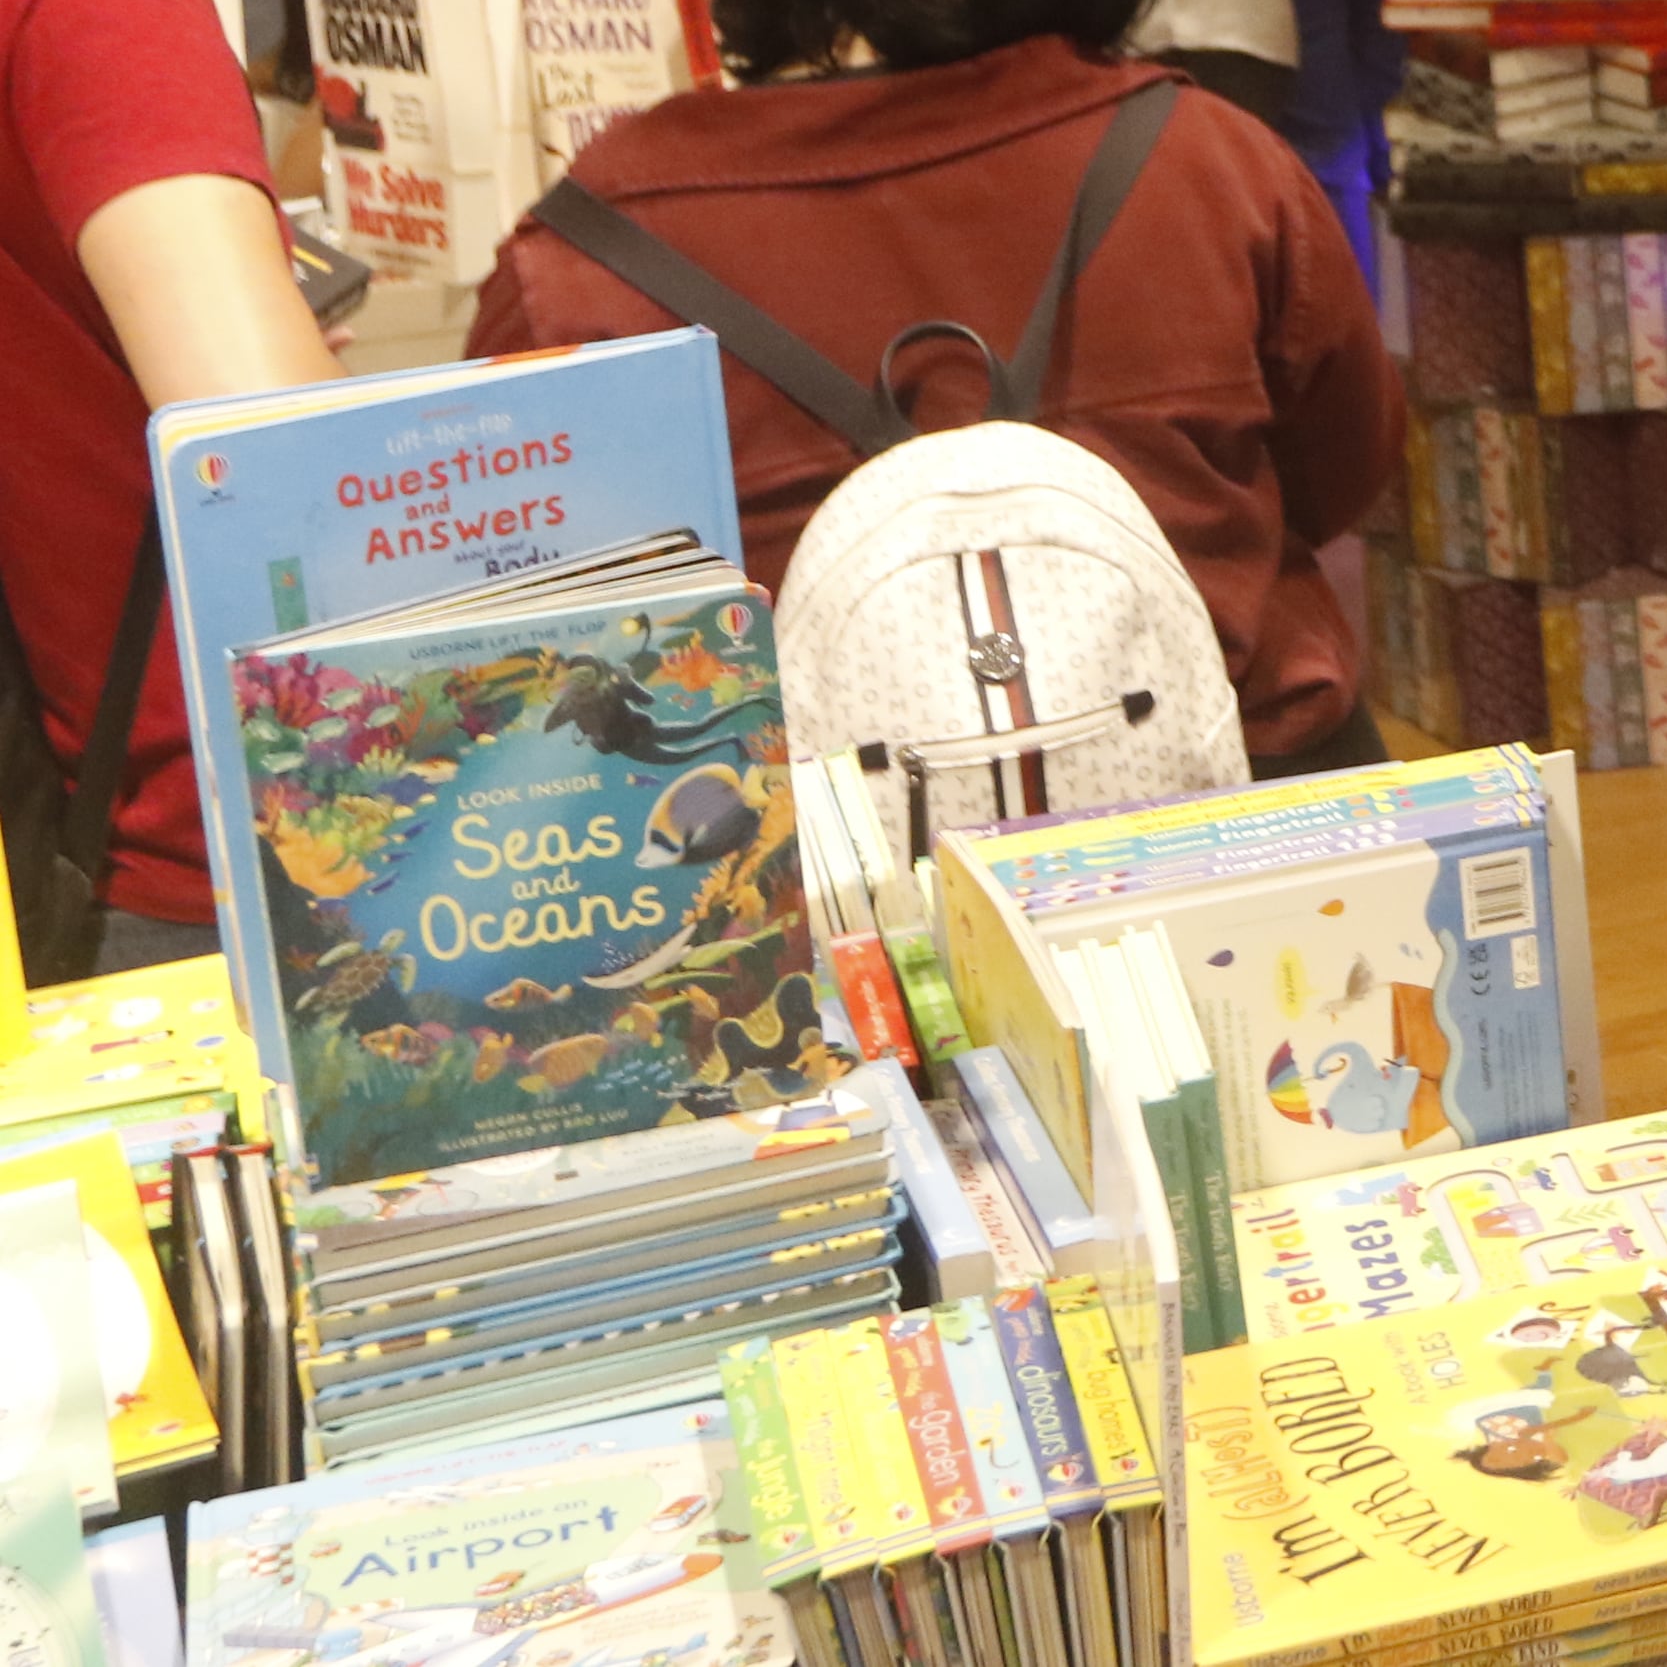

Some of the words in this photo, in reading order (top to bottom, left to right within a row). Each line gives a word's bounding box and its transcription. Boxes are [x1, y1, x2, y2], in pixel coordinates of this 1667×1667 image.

[525, 18, 653, 54] OSMAN
[337, 433, 574, 509] Questions
[364, 494, 568, 565] Answers
[405, 493, 452, 521] and
[409, 637, 486, 662] USBORNE
[525, 625, 560, 645] THE
[566, 618, 607, 638] FLAP
[457, 787, 521, 812] LOOK
[527, 772, 603, 801] INSIDE
[1215, 800, 1340, 831] Fingertrail
[451, 814, 624, 879] Seas
[1215, 831, 1332, 861] Fingertrail
[1218, 811, 1345, 844] Fingertrail
[1213, 845, 1331, 875] Fingertrail
[511, 867, 581, 902] and
[419, 885, 666, 961] Oceans
[1345, 1218, 1421, 1321] Mazes
[1418, 1331, 1466, 1391] HOLES
[1016, 1364, 1069, 1456] dinosaurs
[1083, 1368, 1110, 1414] bug
[1094, 1408, 1127, 1463] homes
[1260, 1357, 1403, 1486] BORED
[909, 1409, 961, 1486] garden
[343, 1505, 618, 1585] Airport
[385, 1526, 449, 1546] Look
[464, 1508, 544, 1532] inside
[553, 1498, 588, 1514] an
[1352, 1469, 1516, 1577] NEVER
[1272, 1515, 1374, 1586] I'm
[1436, 1604, 1491, 1632] NEVER
[1500, 1590, 1553, 1616] BORED
[1437, 1632, 1492, 1658] NEVER
[1500, 1616, 1555, 1643] BORED
[1518, 1639, 1562, 1663] KIND
